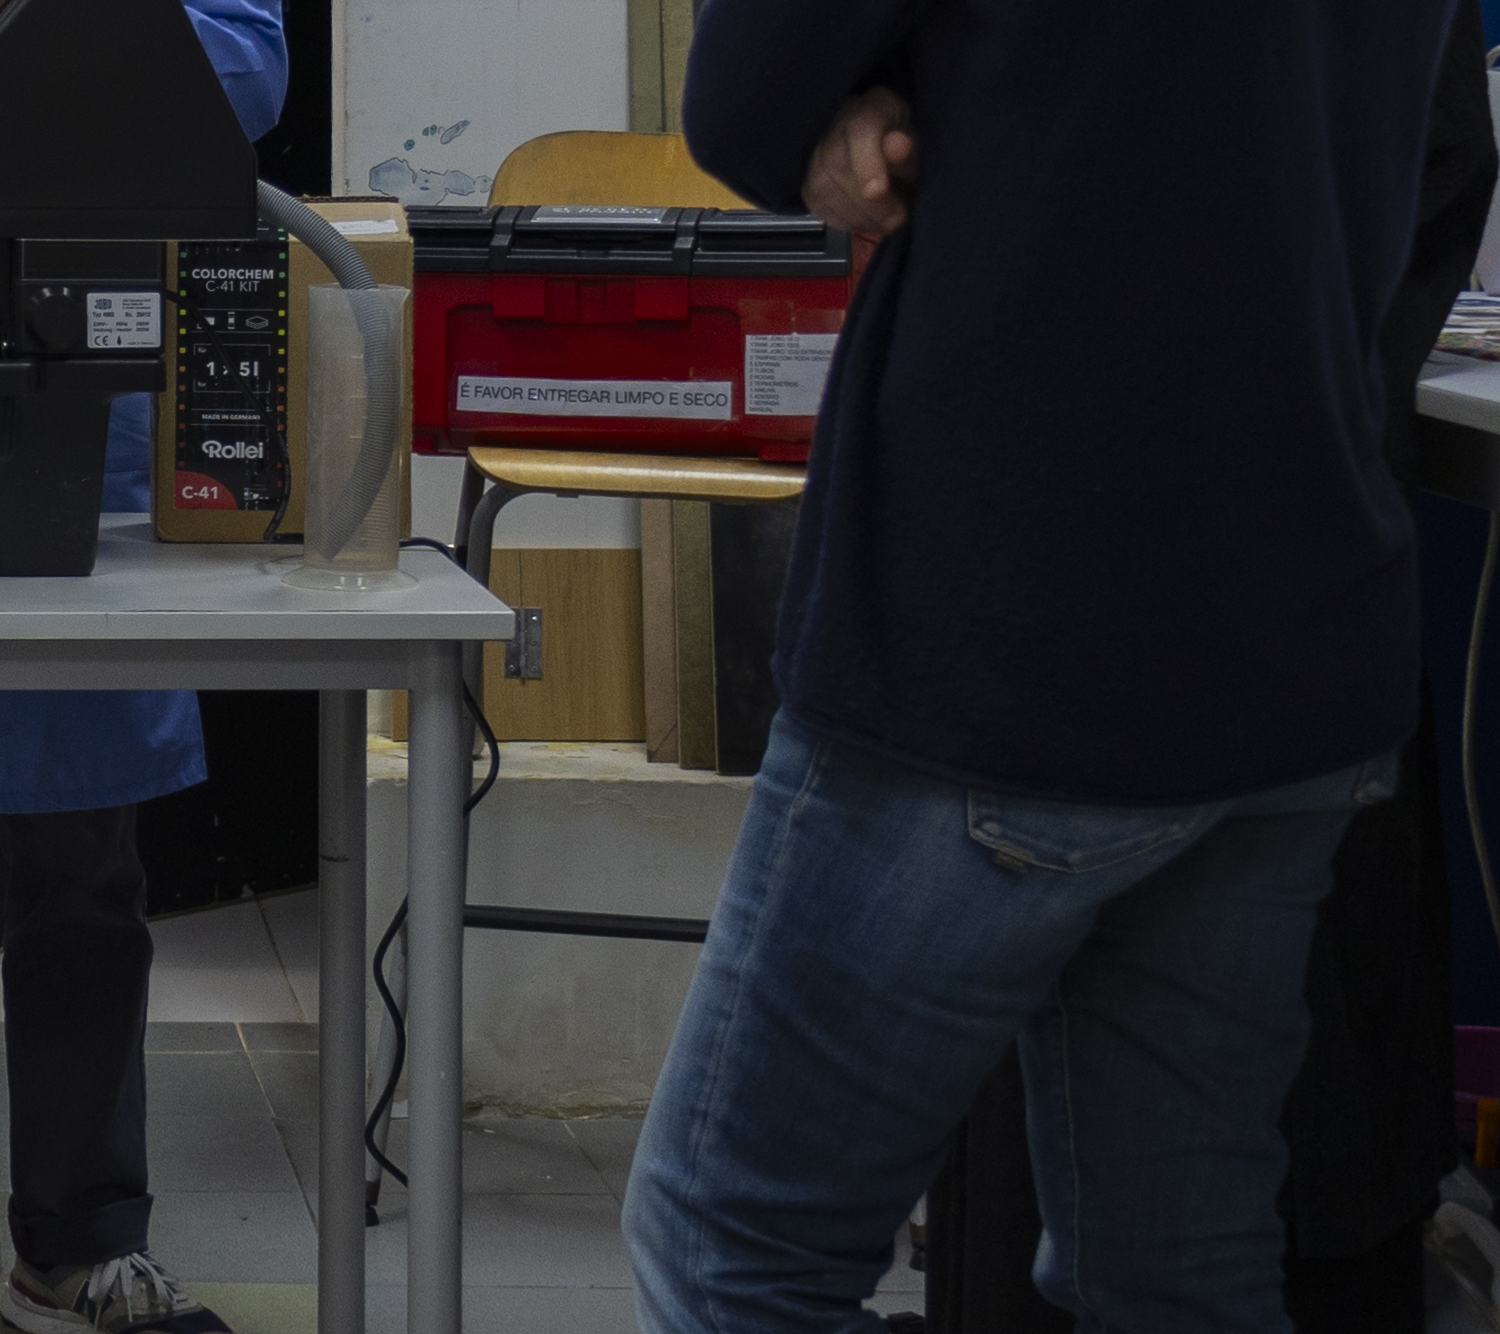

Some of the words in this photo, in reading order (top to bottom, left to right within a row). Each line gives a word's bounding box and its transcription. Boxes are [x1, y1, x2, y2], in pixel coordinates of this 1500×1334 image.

[191, 268, 274, 280] COLORCHEM
[205, 280, 234, 293] C-41
[239, 280, 260, 292] KIT
[206, 361, 215, 377] 1
[460, 381, 470, 398] É
[474, 385, 523, 400] FAVOR
[528, 387, 610, 403] ENTREGAR
[615, 390, 664, 405] LIMPO
[669, 392, 678, 405] E
[683, 392, 728, 407] SECO
[201, 440, 264, 459] Rollei
[181, 485, 219, 500] C-41
